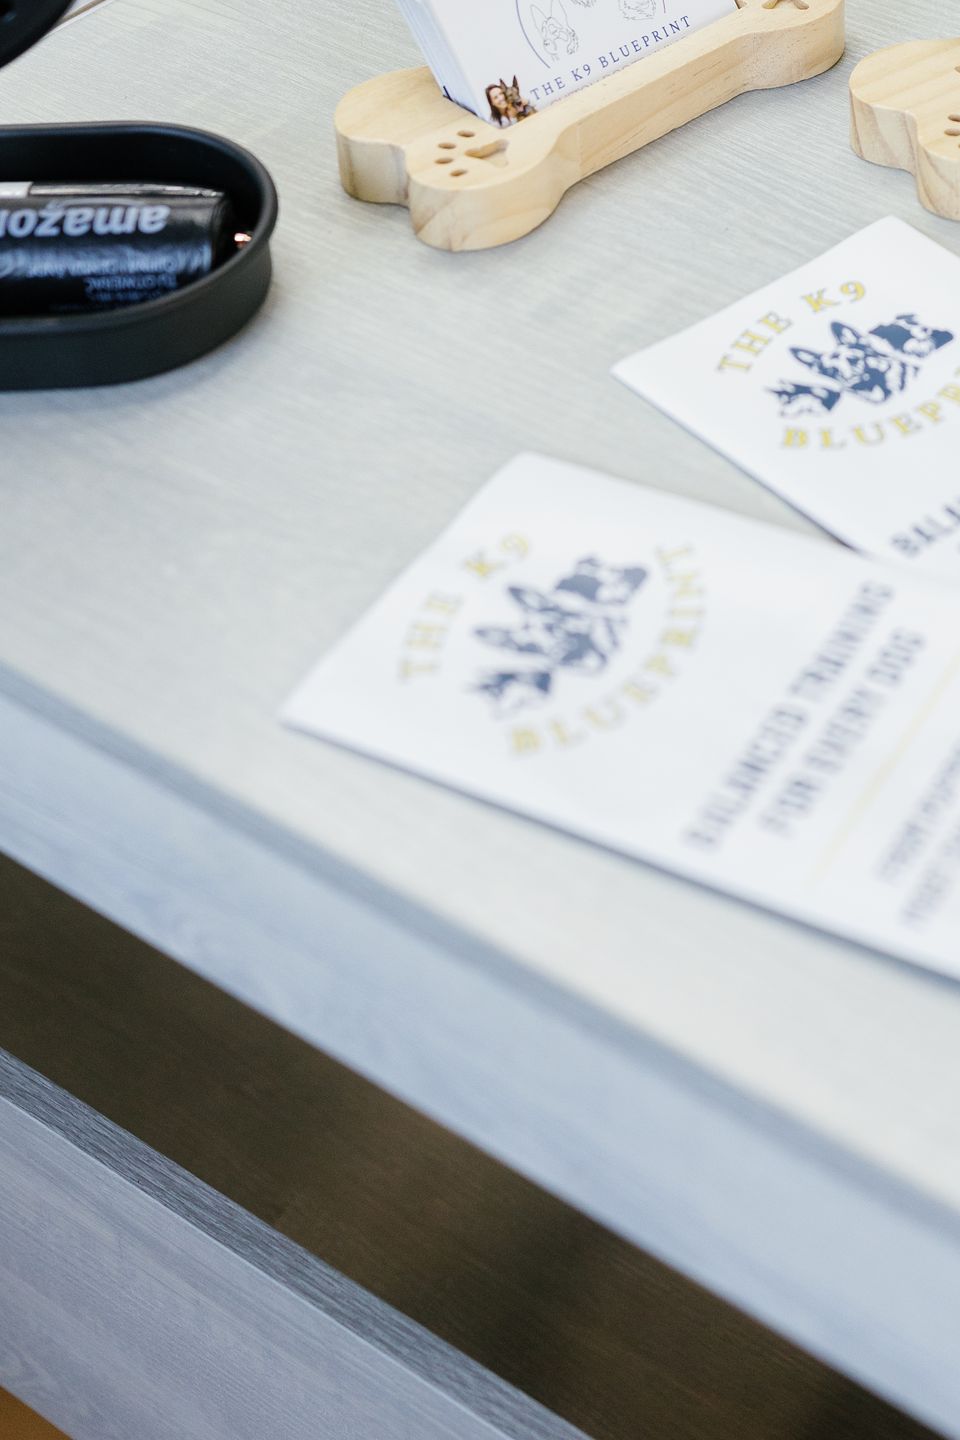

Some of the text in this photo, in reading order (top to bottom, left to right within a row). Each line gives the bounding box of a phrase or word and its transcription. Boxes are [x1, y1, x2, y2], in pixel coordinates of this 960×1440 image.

[530, 15, 691, 101] THE K9 BLUEPRINT
[0, 204, 171, 237] amazo
[716, 281, 866, 373] THE K9
[398, 590, 462, 684] THE
[510, 544, 706, 755] BLUEPRINT
